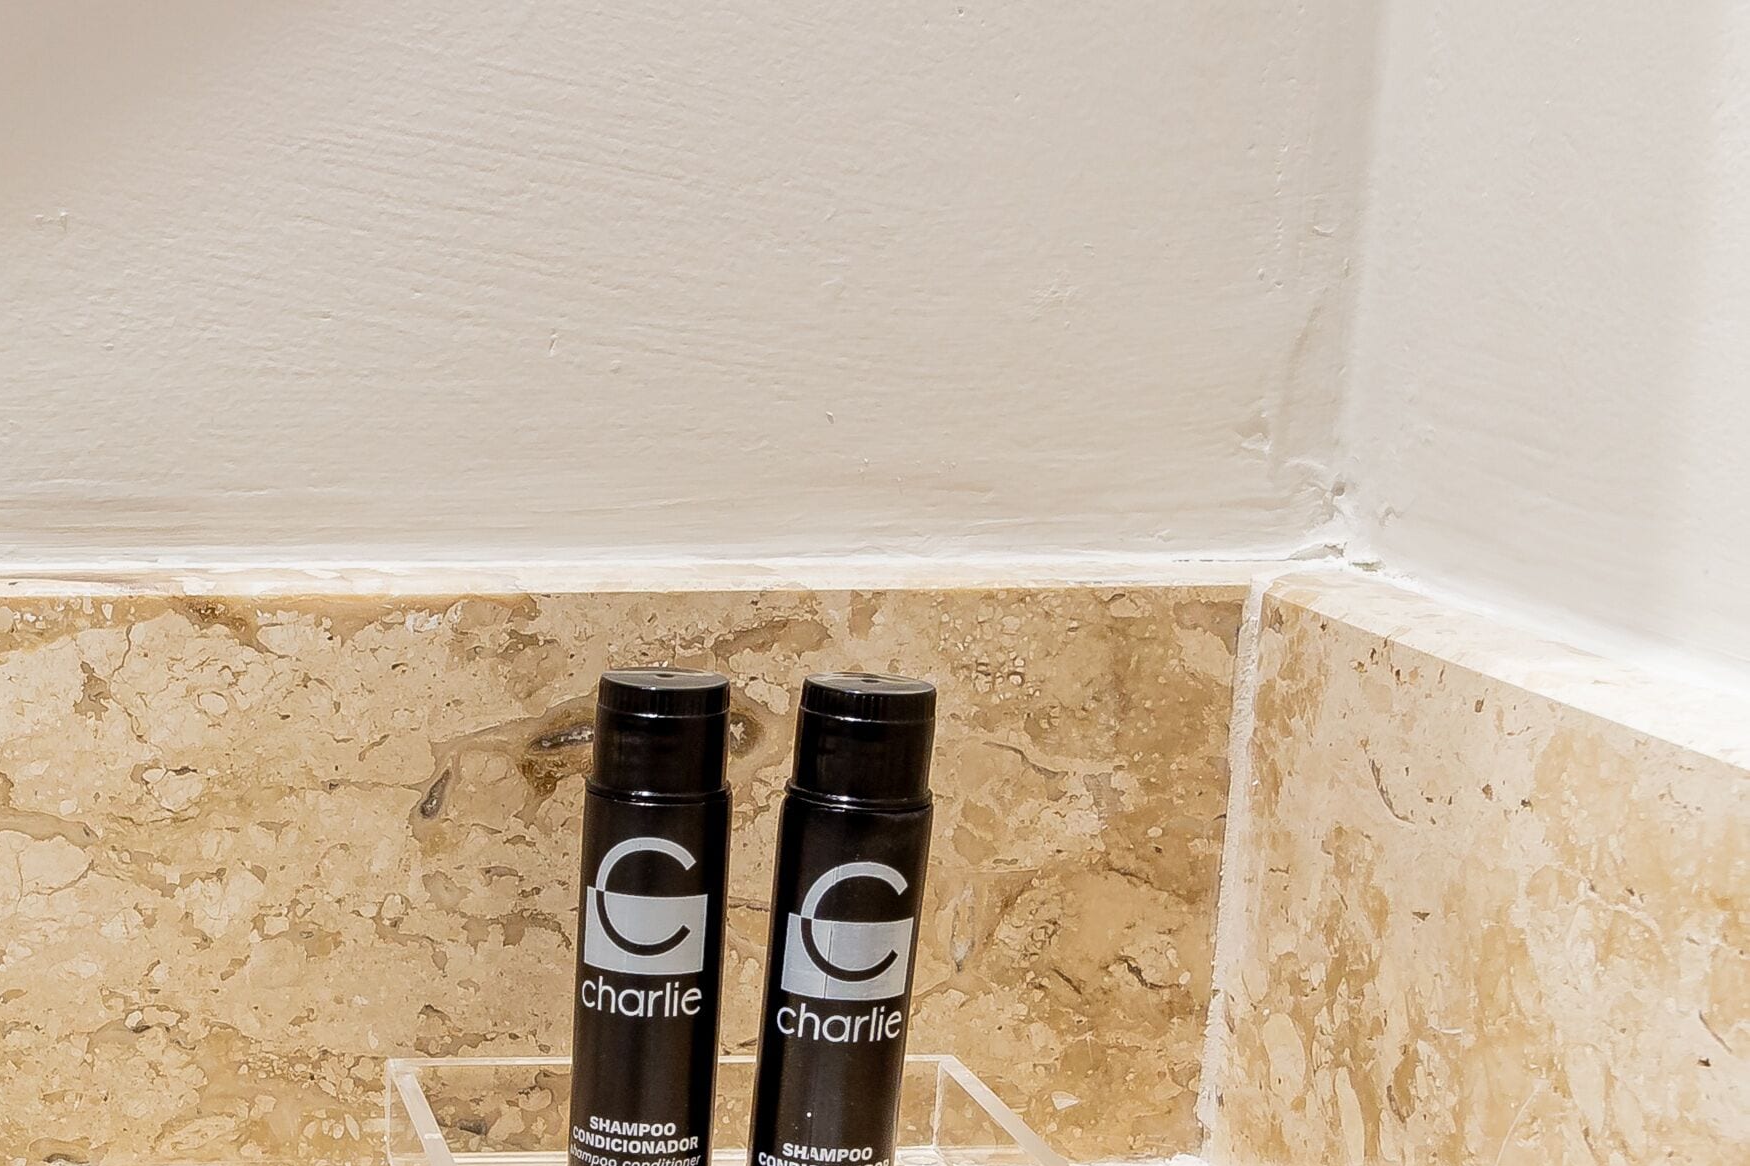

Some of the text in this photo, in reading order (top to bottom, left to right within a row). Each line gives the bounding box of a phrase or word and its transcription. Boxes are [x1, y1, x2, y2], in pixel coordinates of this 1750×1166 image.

[581, 975, 703, 1019] charlie
[776, 1003, 903, 1043] charlie
[572, 1125, 699, 1155] CONDICIONADOR
[589, 1115, 677, 1137] SHAMPOO
[782, 1142, 873, 1163] SHAMPOO
